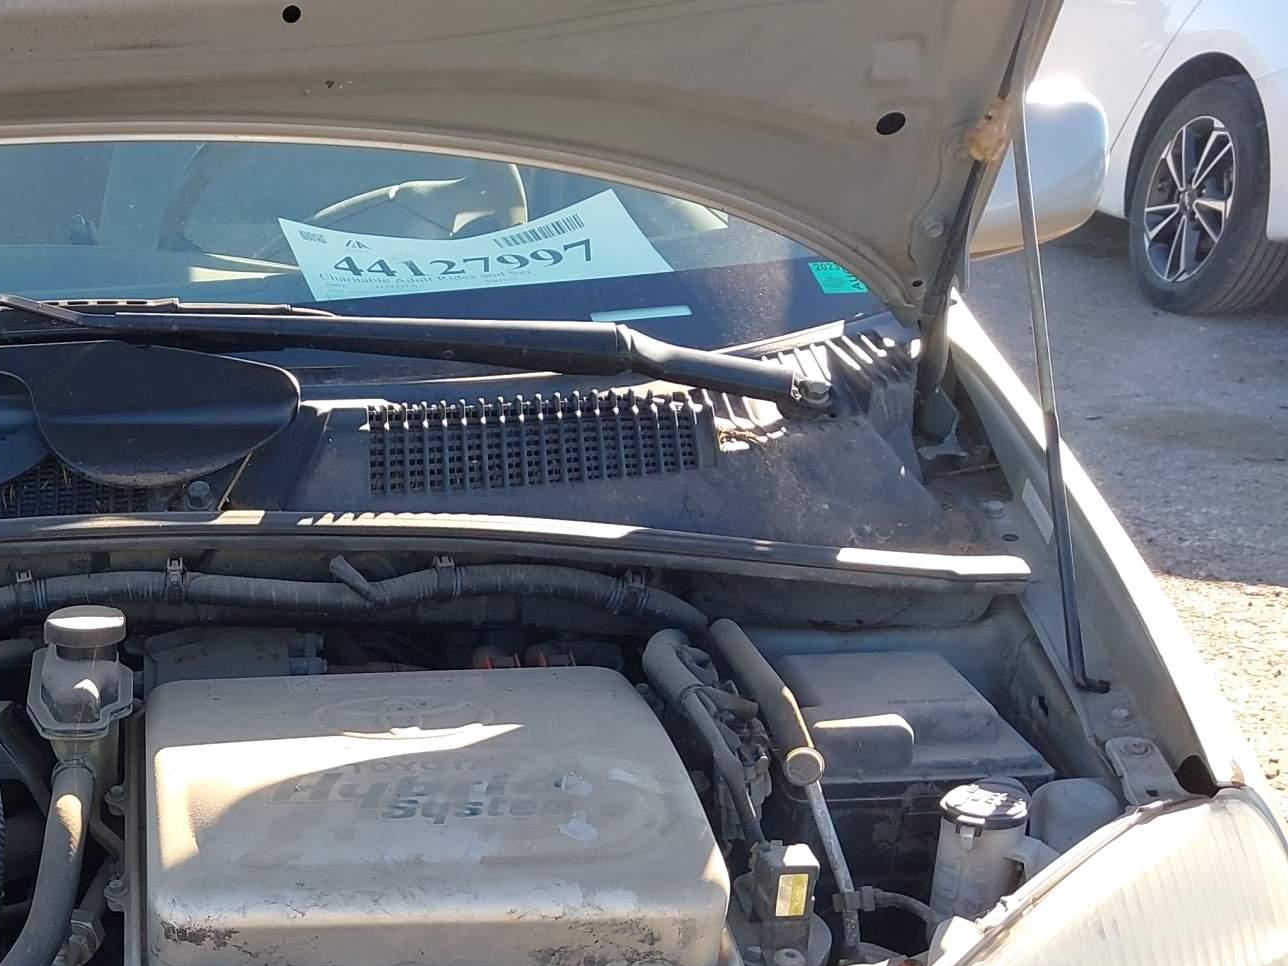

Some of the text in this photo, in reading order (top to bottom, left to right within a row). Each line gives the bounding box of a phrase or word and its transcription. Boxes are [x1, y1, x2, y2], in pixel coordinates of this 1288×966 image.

[334, 238, 592, 276] 44127997
[319, 272, 393, 284] Charitable
[396, 275, 432, 284] Adult
[437, 273, 477, 282] Rides
[480, 271, 505, 279] and
